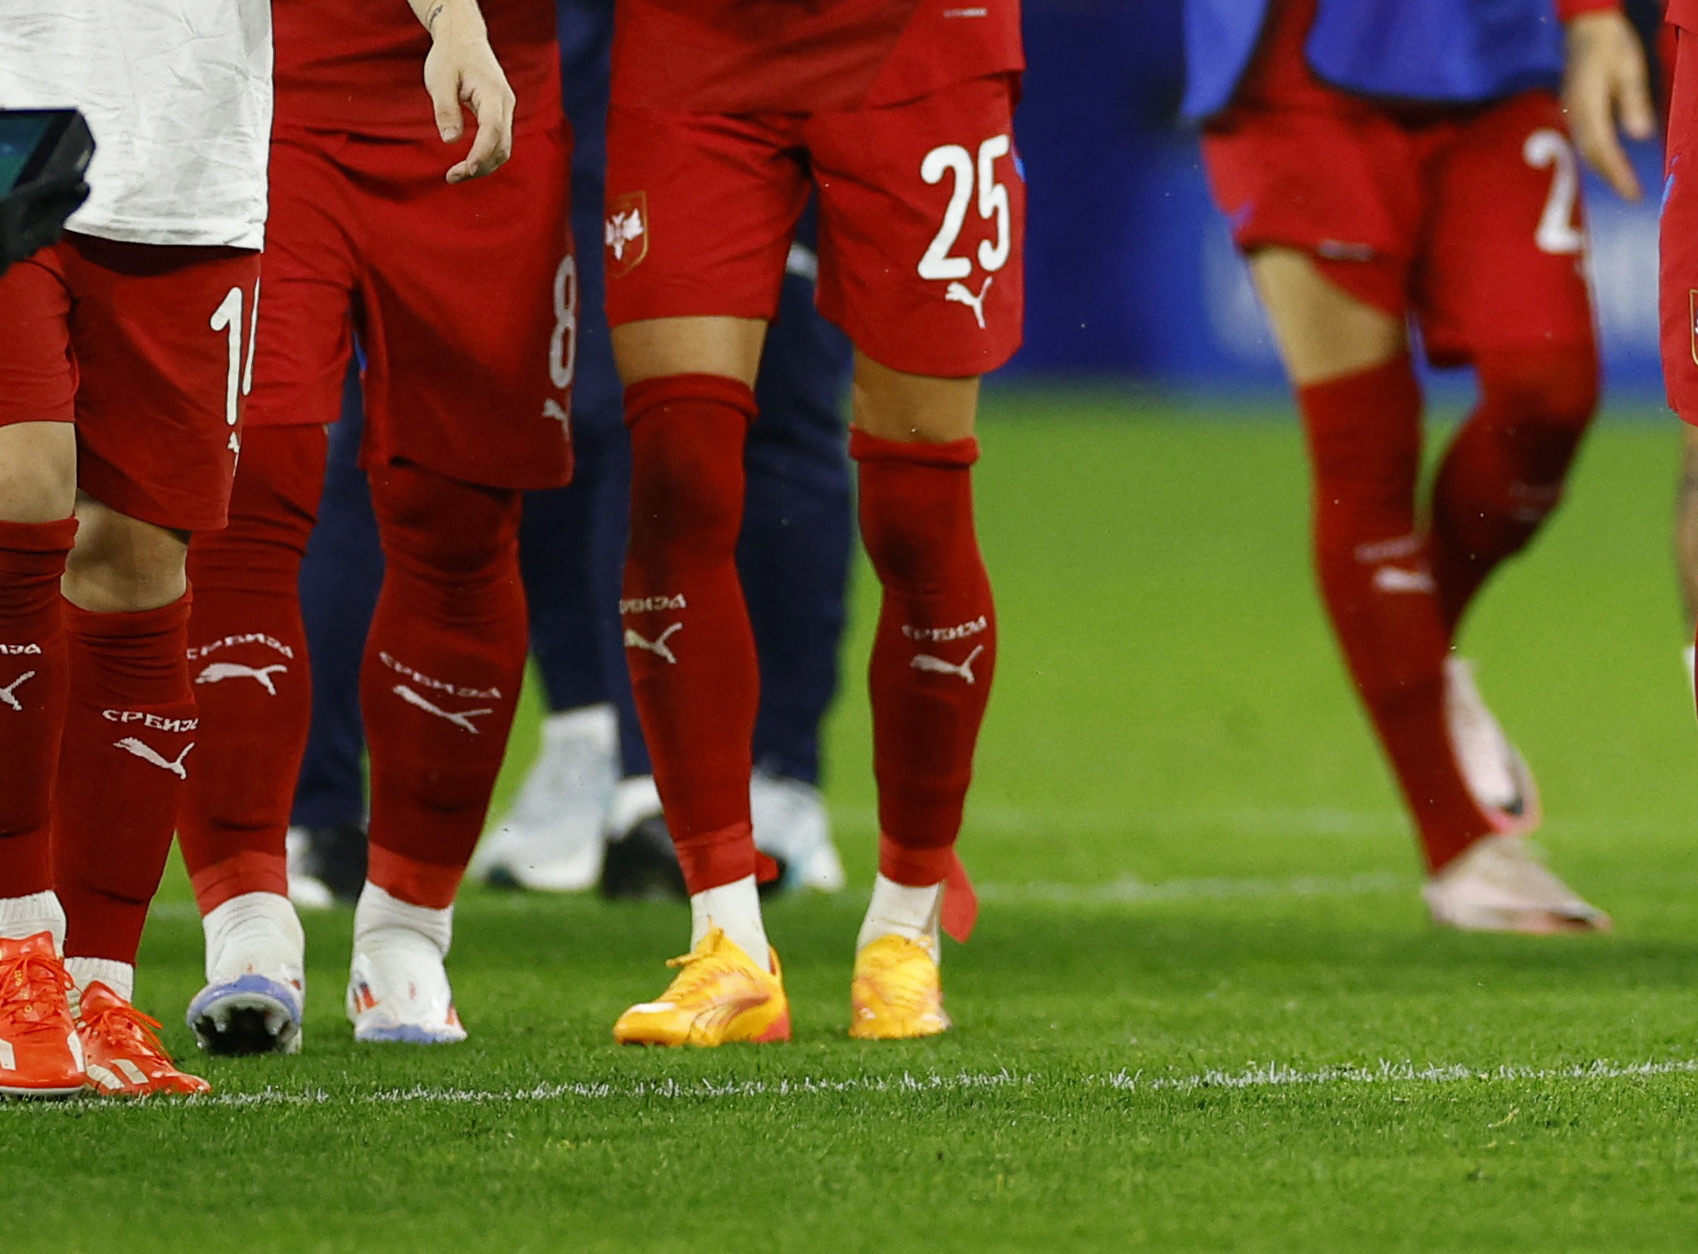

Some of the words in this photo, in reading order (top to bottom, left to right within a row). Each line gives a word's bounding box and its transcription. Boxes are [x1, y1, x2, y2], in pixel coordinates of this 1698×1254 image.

[917, 134, 1012, 280] 25
[549, 252, 578, 391] 8
[102, 708, 199, 733] СРБИЈ
